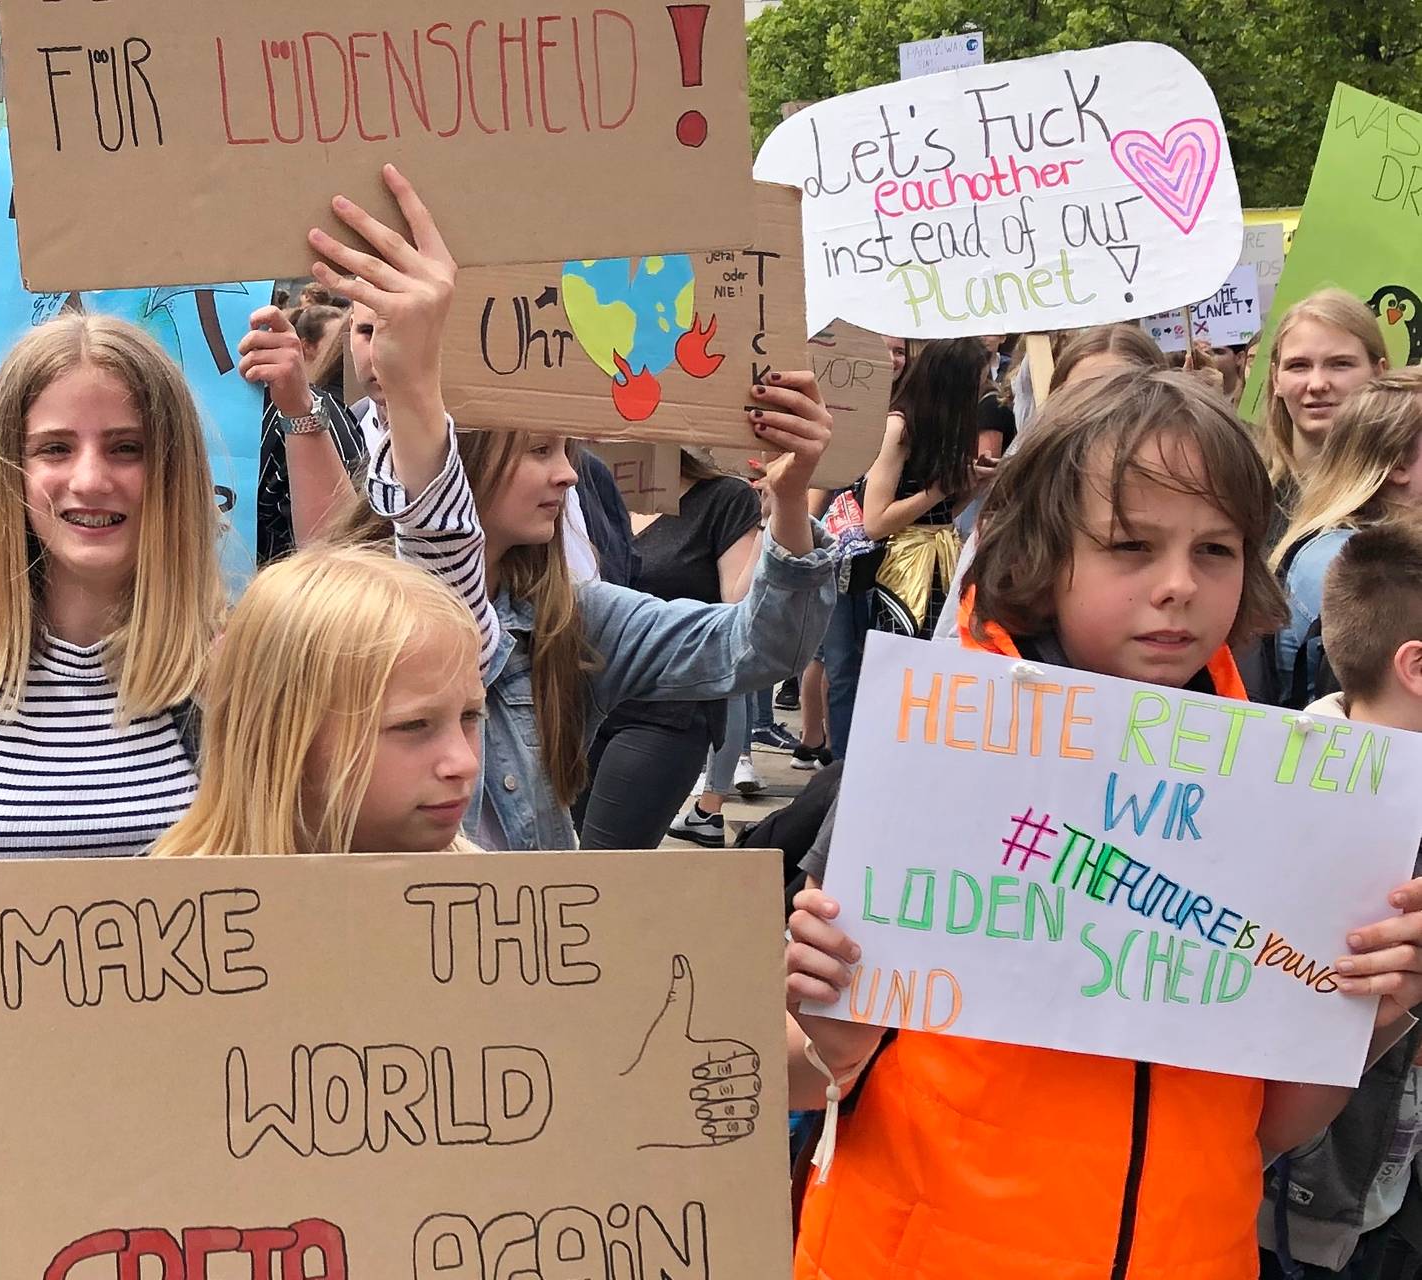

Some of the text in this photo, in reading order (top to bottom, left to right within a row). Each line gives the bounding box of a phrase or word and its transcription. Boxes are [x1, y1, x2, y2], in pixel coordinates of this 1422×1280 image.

[37, 36, 164, 152] FÜR
[804, 69, 1111, 198] Let's Fuck
[1335, 87, 1421, 156] WAS
[875, 155, 1084, 217] eachother
[722, 267, 748, 281] oder
[822, 195, 1142, 278] instead of our
[480, 296, 574, 375] Uhr
[896, 668, 1096, 760] HEUTE
[1104, 772, 1205, 841] WIR
[0, 882, 602, 1010] MAKE THE
[849, 965, 962, 1033] UND
[226, 1042, 552, 1159] WORLD
